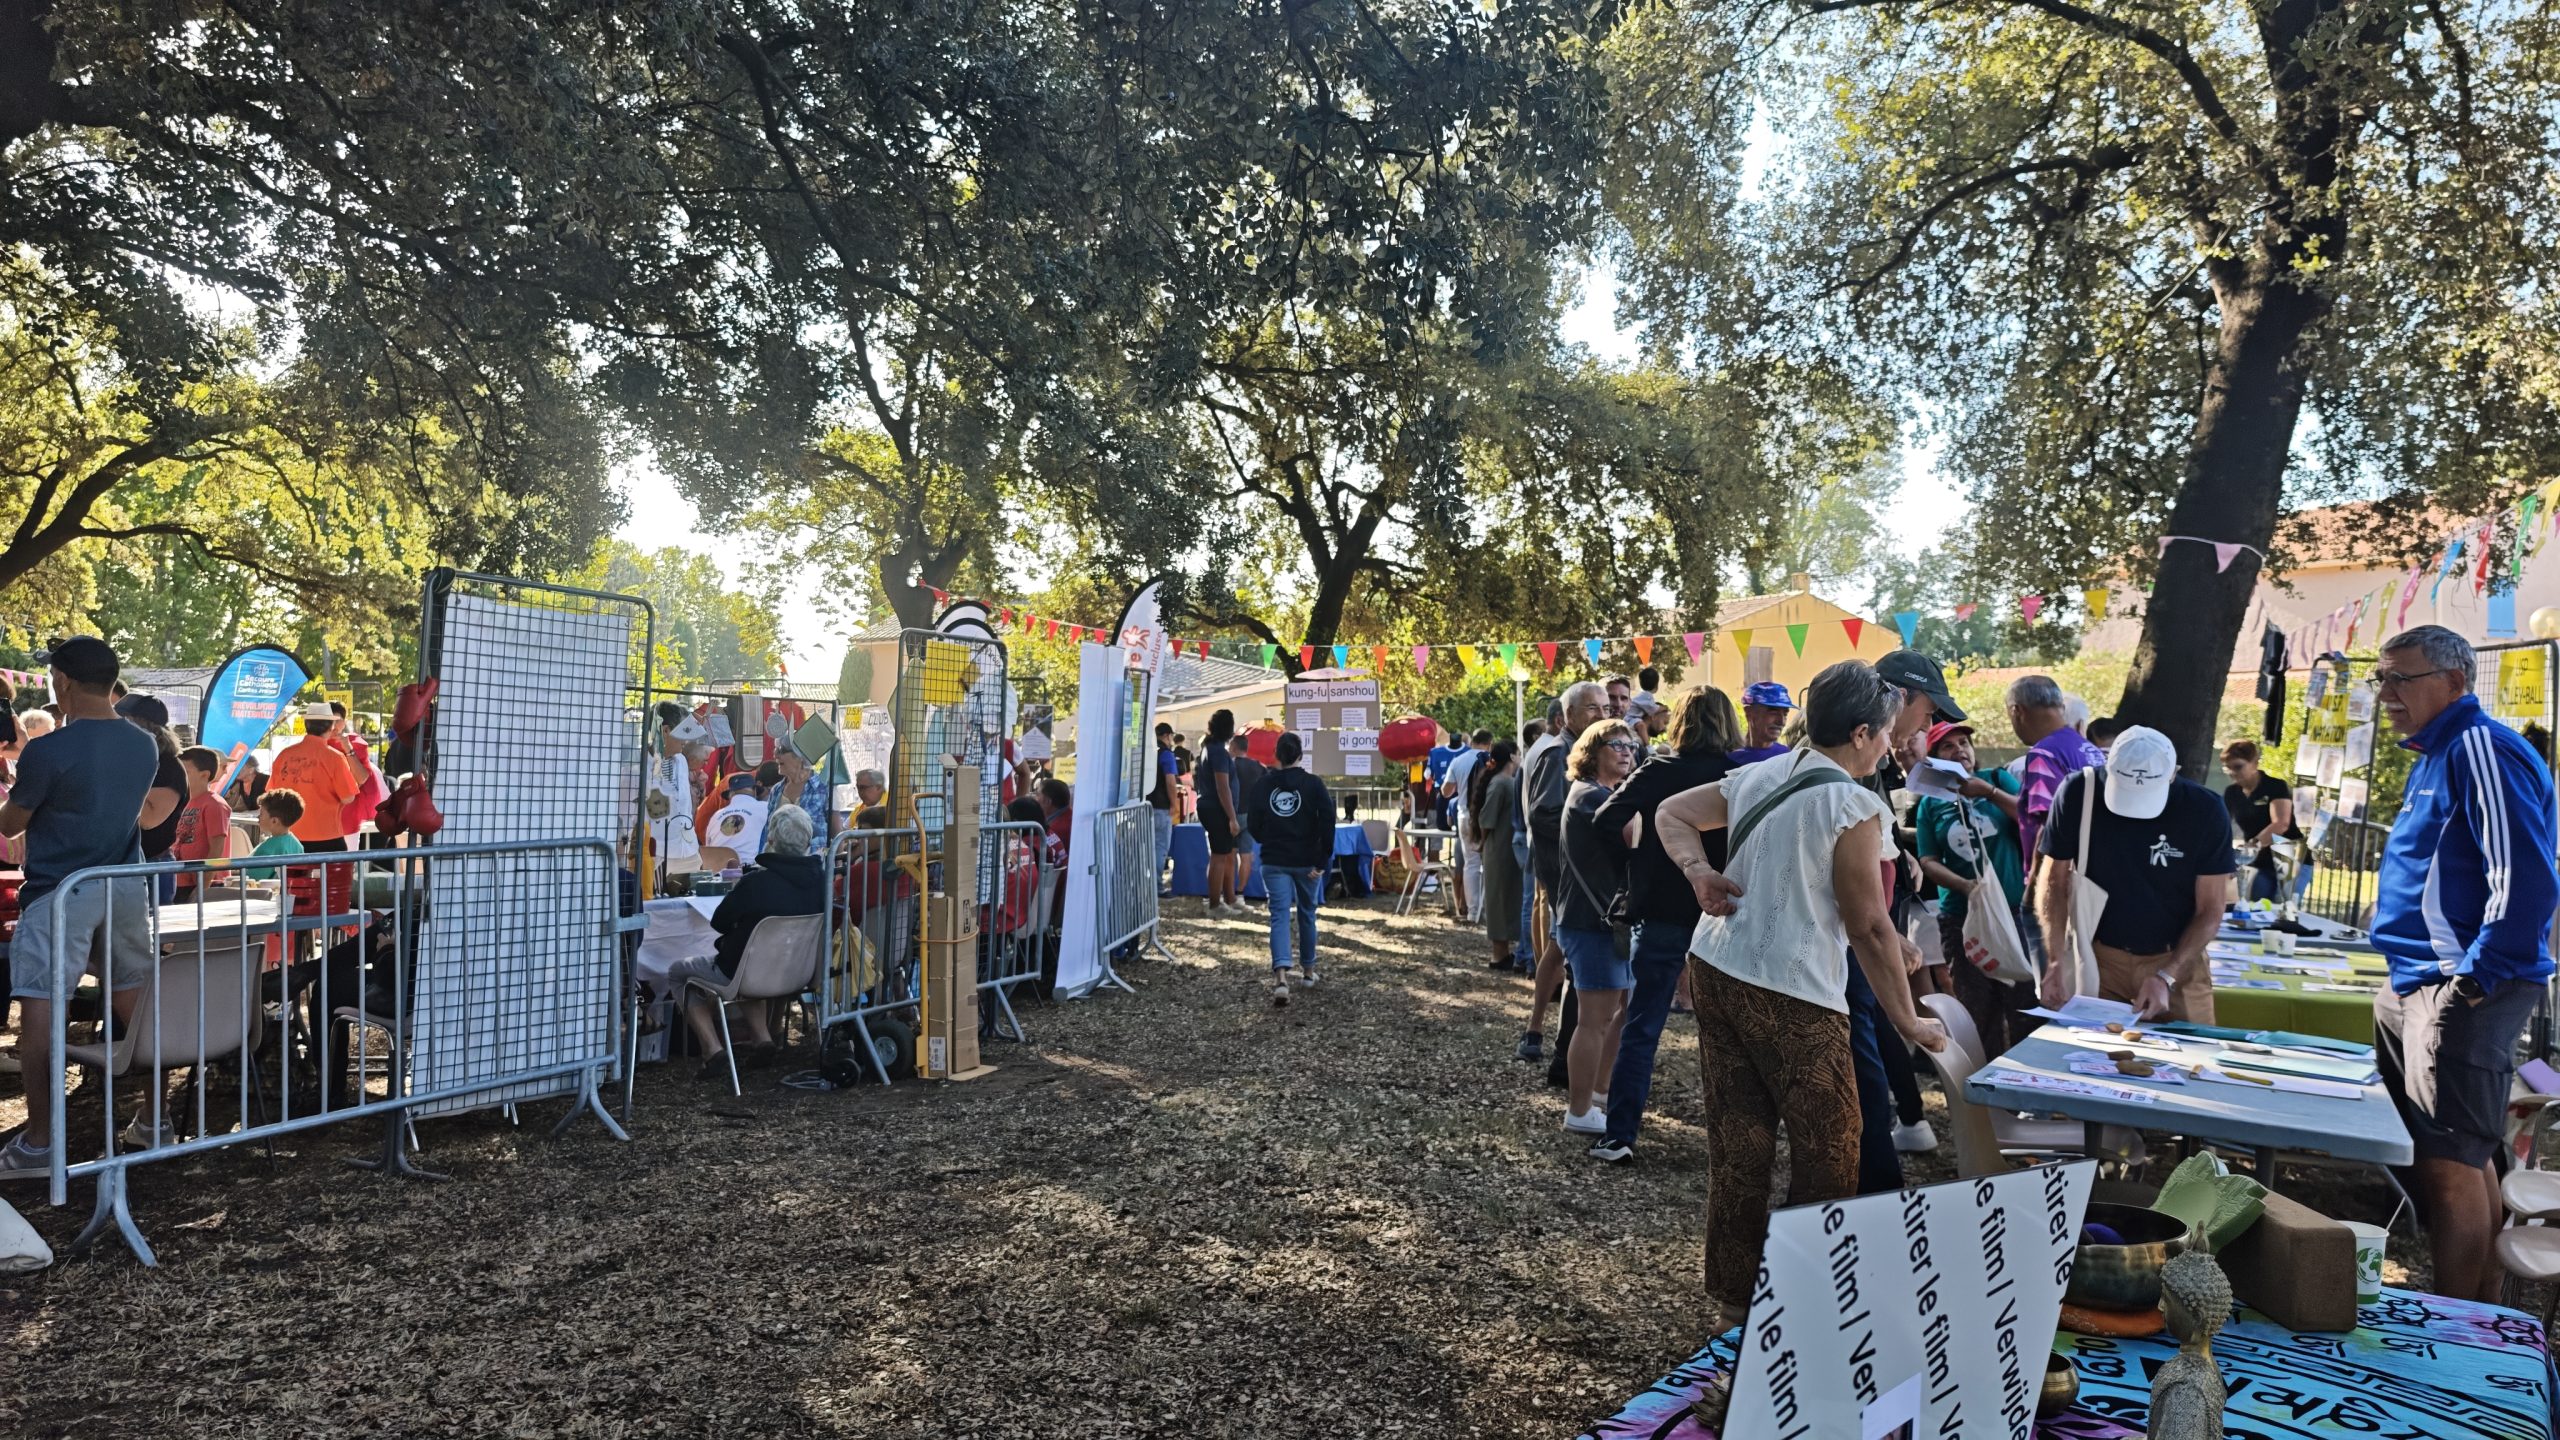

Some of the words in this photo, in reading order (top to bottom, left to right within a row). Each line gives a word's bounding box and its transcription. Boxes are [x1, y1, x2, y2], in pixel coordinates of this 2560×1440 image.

[1288, 686, 1327, 699] kung-fu
[1330, 685, 1375, 697] sanshou
[868, 712, 889, 726] CLUB
[1339, 734, 1349, 747] qi
[1351, 736, 1379, 748] gong
[1980, 1207, 2006, 1281] film
[1829, 1234, 1861, 1314] film
[1916, 1273, 1941, 1316] le
[1757, 1306, 1785, 1352] le
[1923, 1314, 1950, 1388] film
[1766, 1349, 1799, 1430] film
